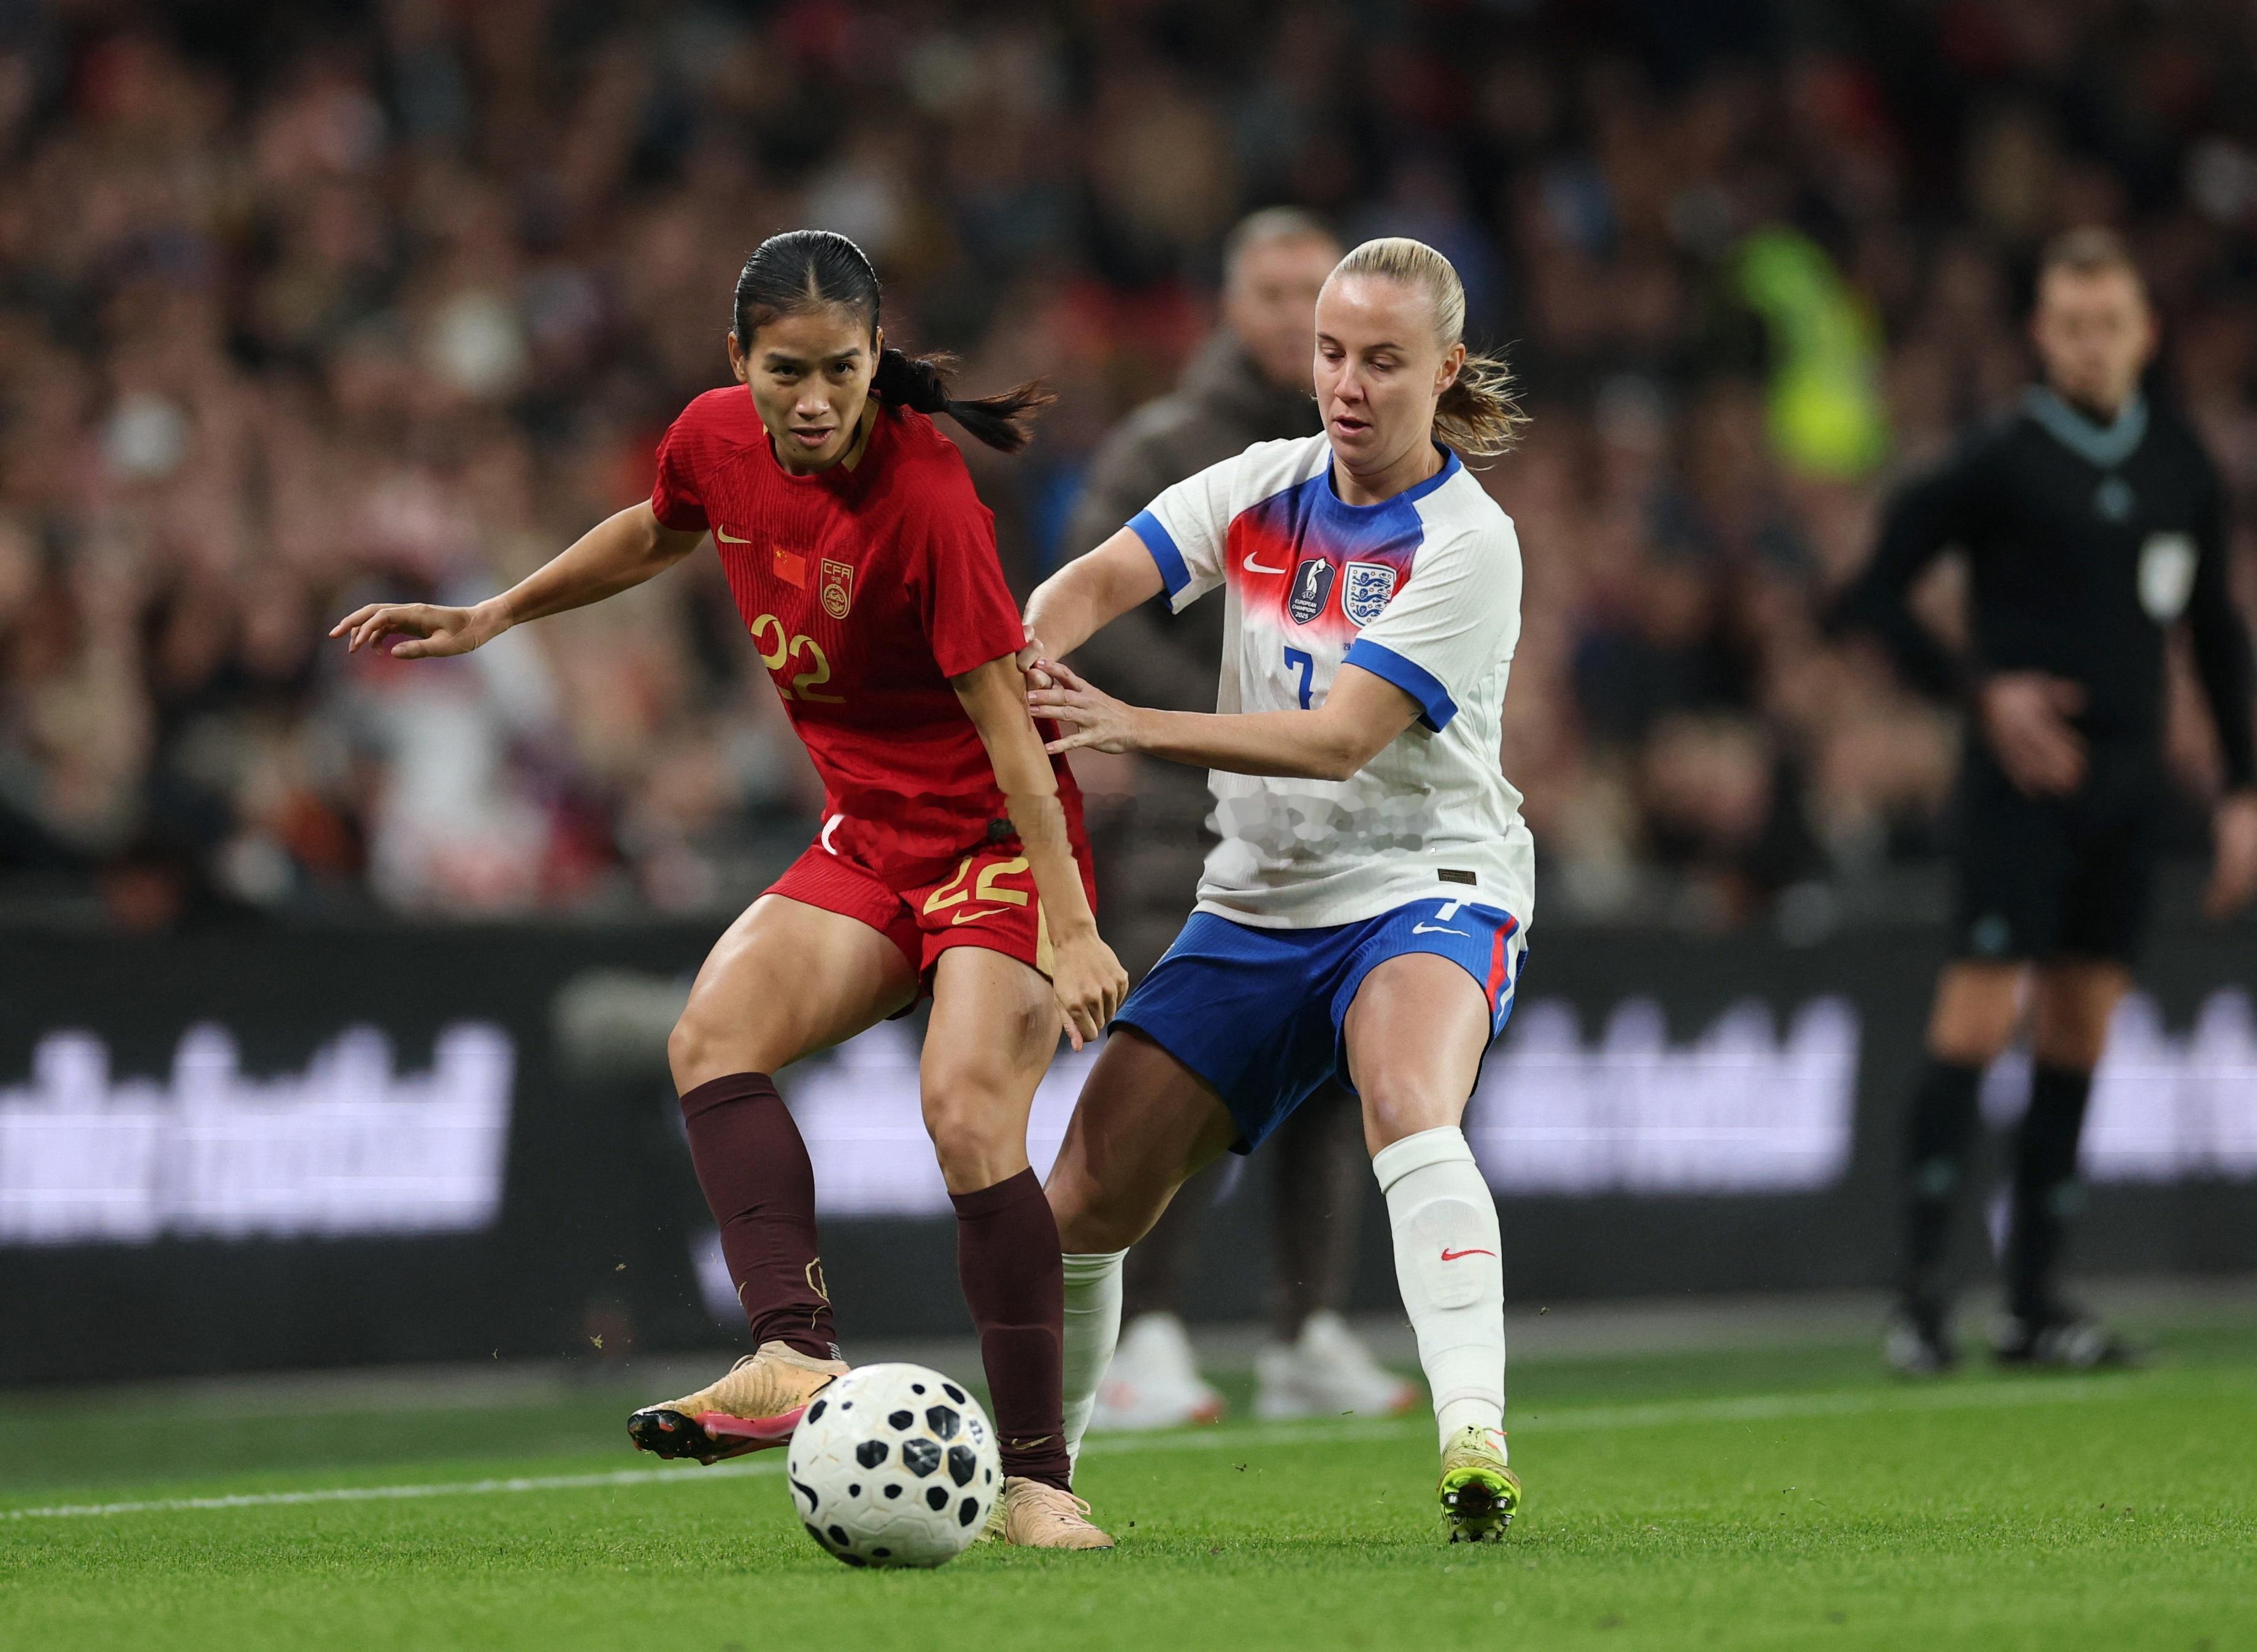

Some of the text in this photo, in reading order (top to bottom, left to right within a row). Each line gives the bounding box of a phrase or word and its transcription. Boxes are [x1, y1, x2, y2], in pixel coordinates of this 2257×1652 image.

[824, 563, 850, 580] CFA
[1294, 599, 1317, 608] EUROPEAN
[1302, 592, 1315, 601] UEFA
[1291, 604, 1317, 614] CHAMPIONS
[751, 614, 847, 703] 22
[1284, 646, 1313, 710] 7
[923, 856, 1029, 915] 22
